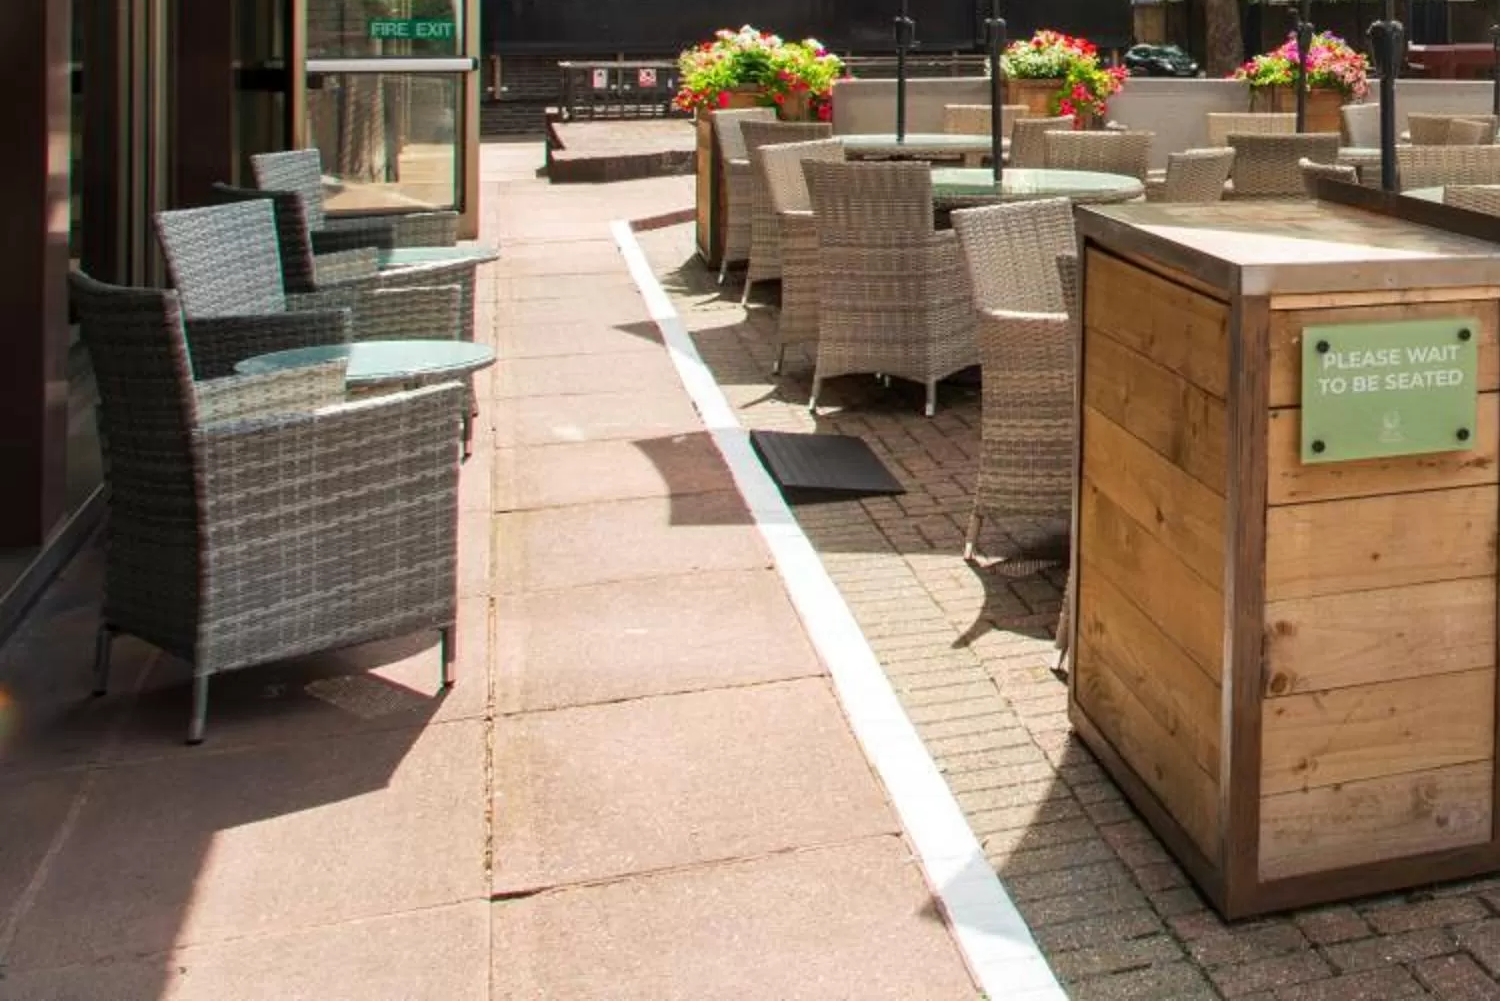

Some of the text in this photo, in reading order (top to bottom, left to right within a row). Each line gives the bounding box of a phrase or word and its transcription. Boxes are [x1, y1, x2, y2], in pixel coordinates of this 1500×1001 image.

[371, 22, 454, 36] FIRE EXIT
[1322, 345, 1461, 370] PLEASE WAIT
[1319, 369, 1464, 395] TO BE SEATED
